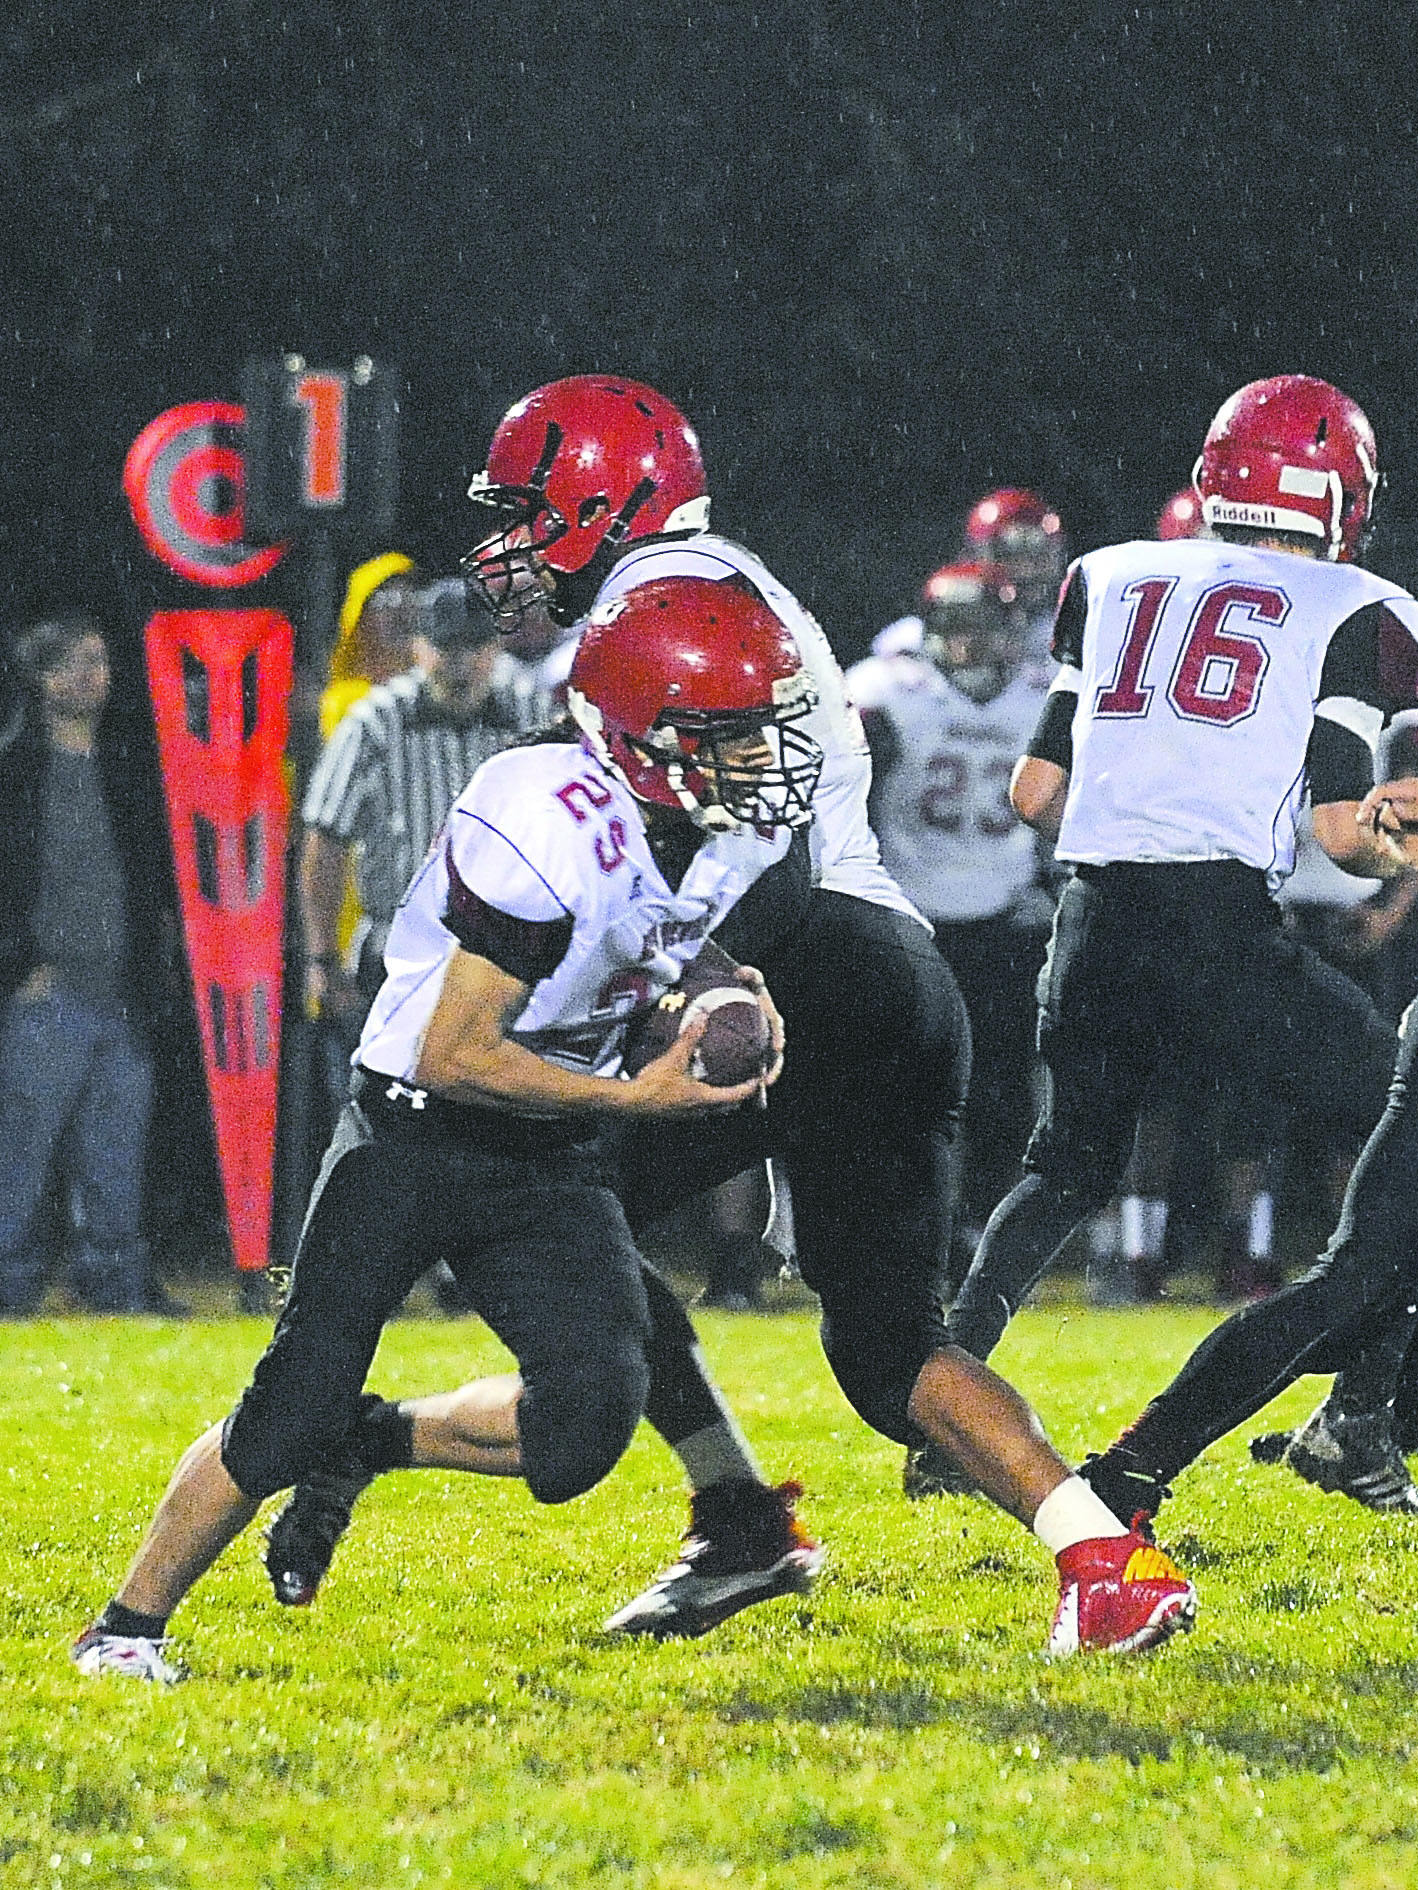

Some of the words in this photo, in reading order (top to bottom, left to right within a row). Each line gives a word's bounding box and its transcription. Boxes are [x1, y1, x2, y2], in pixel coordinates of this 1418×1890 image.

[295, 373, 346, 504] 1
[1212, 505, 1276, 524] Riddell
[1093, 576, 1292, 728] 16
